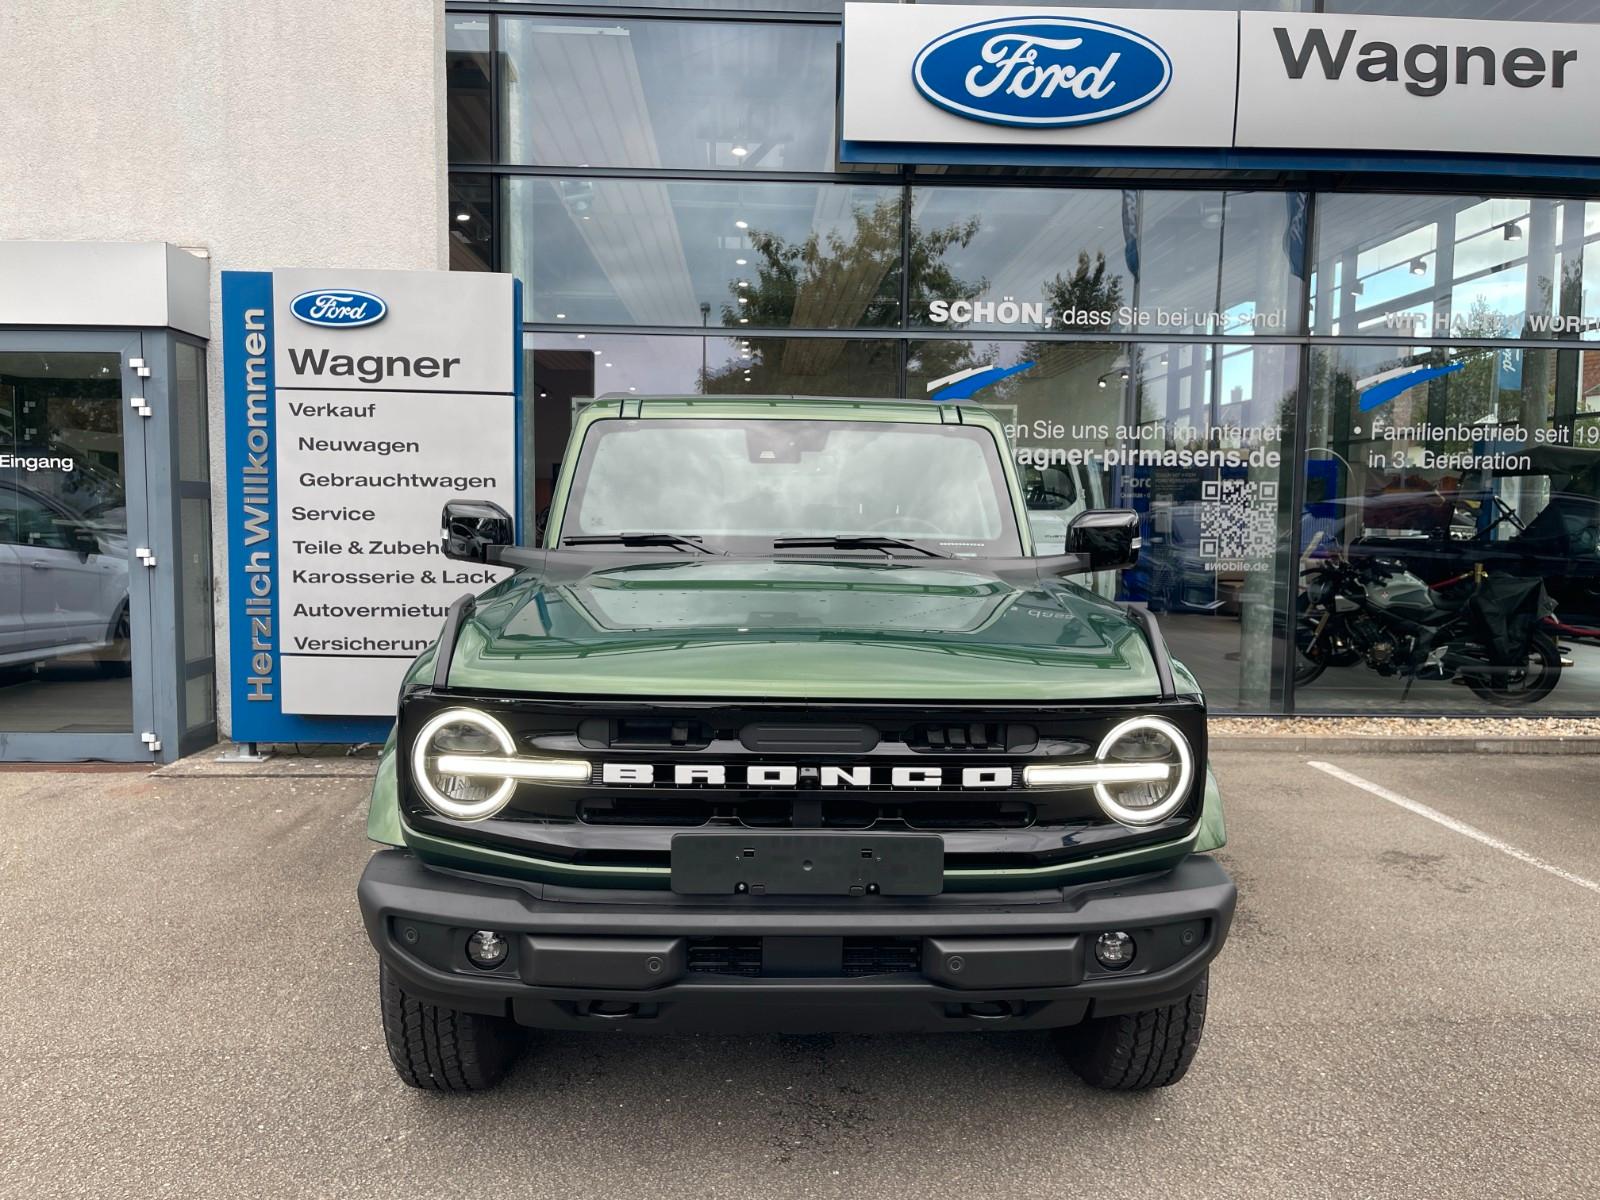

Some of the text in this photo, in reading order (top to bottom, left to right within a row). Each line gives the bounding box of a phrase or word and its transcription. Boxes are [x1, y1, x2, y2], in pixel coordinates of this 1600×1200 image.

[964, 31, 1121, 101] Ford
[1273, 26, 1578, 97] Wagner
[309, 294, 368, 320] Ford
[928, 296, 1288, 329] SCHÖN, dass Sie bei uns sind!
[1384, 312, 1428, 330] WIR
[287, 347, 461, 384] Wagner
[288, 402, 376, 418] Verkauf
[1033, 420, 1065, 440] Sie
[1072, 424, 1109, 440] uns
[1116, 420, 1166, 441] auch
[1174, 422, 1196, 440] im
[1204, 422, 1282, 442] Internet
[1371, 422, 1528, 443] Familienbetrieb
[1535, 425, 1569, 443] seit
[298, 437, 420, 456] Neuwagen
[0, 454, 74, 472] Eingang
[1369, 451, 1531, 471] in 3. Generation
[299, 472, 497, 492] Gebrauchtwagen
[243, 308, 273, 701] Herzlich Willkommen
[291, 506, 376, 521] Service
[293, 540, 342, 555] Teile
[348, 541, 364, 555] &
[1210, 561, 1270, 572] mobile.de
[292, 569, 497, 585] Karosserie & Lack
[602, 763, 1012, 787] BRONCO
